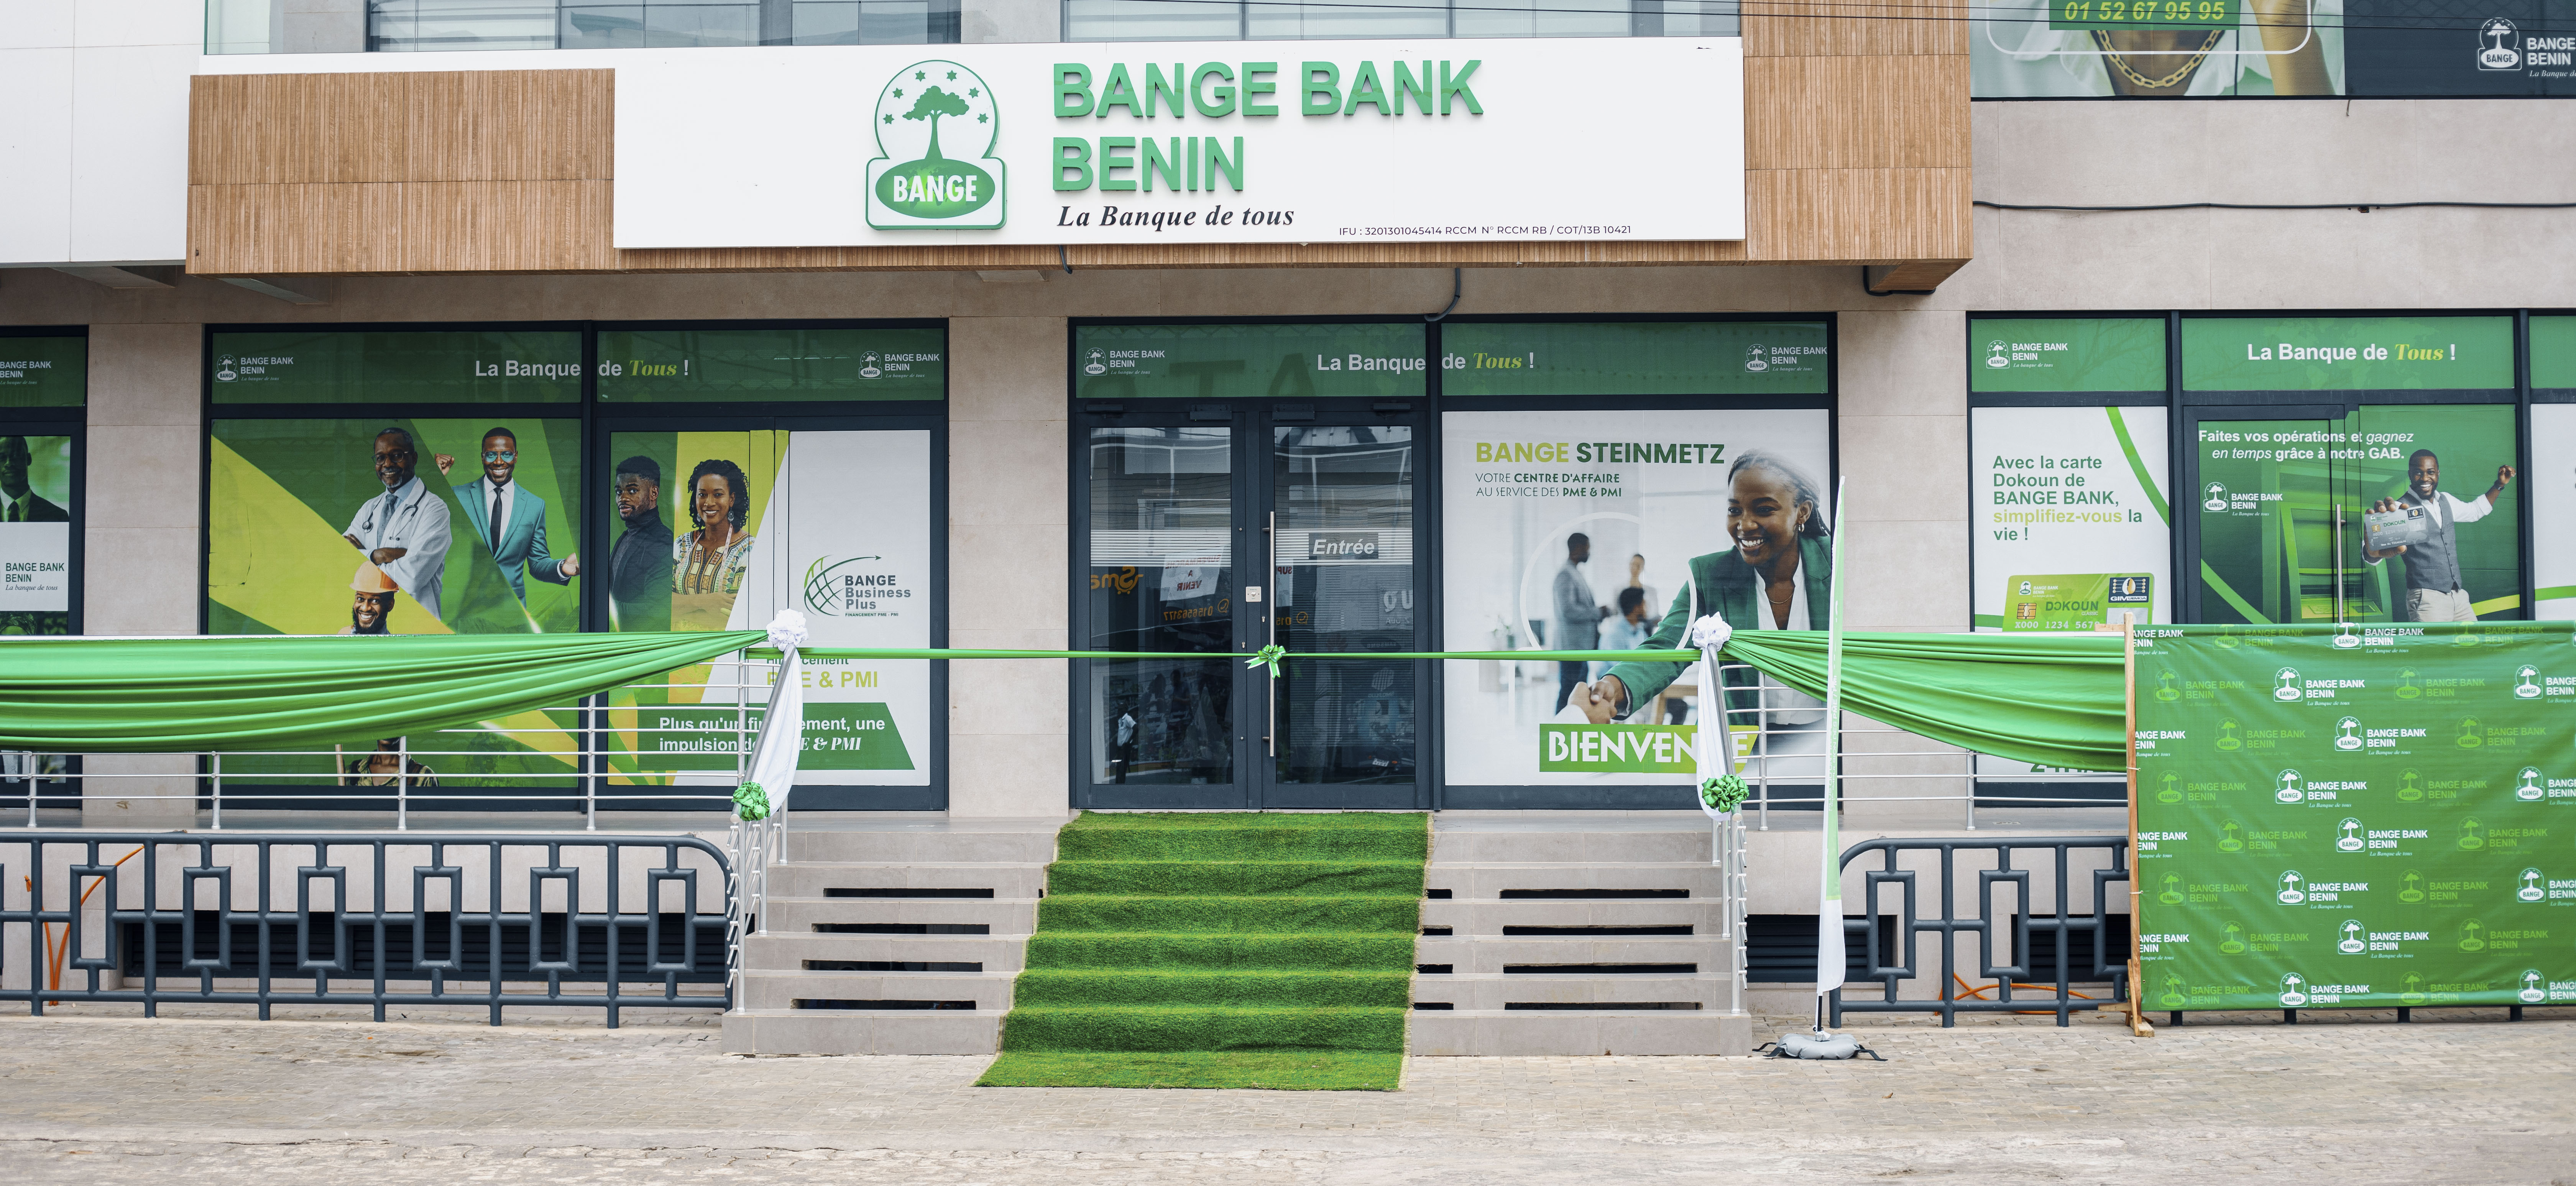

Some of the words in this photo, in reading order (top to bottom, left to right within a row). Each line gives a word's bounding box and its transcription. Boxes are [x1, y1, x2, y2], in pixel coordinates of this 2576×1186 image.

[2065, 2, 2090, 20] 01
[2098, 2, 2126, 20] 52
[2132, 2, 2158, 20] 67
[2164, 2, 2191, 20] 95
[2198, 2, 2225, 20] 95
[2527, 37, 2576, 50] BANGE
[2486, 54, 2513, 62] BANGE
[2527, 53, 2571, 65] BENIN
[2541, 70, 2568, 79] Banque
[1053, 62, 1278, 119] BANGE
[1302, 60, 1484, 117] BANK
[1053, 135, 1243, 192] BENIN
[894, 175, 977, 202] BANGE
[1056, 206, 1090, 226] La
[1099, 206, 1196, 232] Banque
[1205, 205, 1233, 225] de
[1242, 208, 1294, 225] tous
[1365, 227, 1442, 235] 3201301045414
[1549, 225, 1554, 235] /
[1557, 225, 1600, 235] COT/13B
[2012, 343, 2042, 351] BANGE
[2044, 343, 2068, 351] BANK
[2247, 343, 2272, 360] La
[2278, 343, 2357, 364] Banque
[2362, 343, 2388, 360] de
[2395, 343, 2444, 361] Tous
[2450, 343, 2456, 360] !
[476, 360, 498, 376] La
[506, 360, 581, 380] Banque
[598, 360, 622, 376] de
[629, 360, 677, 376] Tous
[684, 360, 688, 376] !
[1318, 354, 1341, 371] La
[1349, 354, 1426, 375] Banque
[1442, 353, 1466, 369] de
[1473, 353, 1522, 369] Tous
[1530, 352, 1534, 368] !
[2199, 430, 2240, 442] Faites
[2244, 433, 2269, 442] vos
[2273, 430, 2346, 445] opérations
[2351, 431, 2362, 442] et
[2366, 433, 2414, 445] gagnez
[1477, 442, 1569, 463] BANGE
[1577, 442, 1724, 464] STEINMETZ
[2212, 450, 2228, 458] en
[2232, 447, 2272, 462] temps
[2275, 447, 2314, 462] grâce
[2318, 447, 2326, 459] à
[2331, 448, 2365, 459] notre
[2369, 447, 2404, 459] GAB.
[1993, 455, 2034, 469] Avec
[2040, 455, 2054, 469] la
[2060, 456, 2102, 469] carte
[1475, 473, 1510, 483] VOTRE
[1514, 473, 1558, 483] CENTRE
[1562, 473, 1620, 483] D'AFFAIRE
[1994, 473, 2058, 487] Dokoun
[2065, 473, 2085, 487] de
[1476, 487, 1492, 496] AU
[1496, 487, 1538, 496] SERVICE
[1541, 487, 1559, 496] DES
[1563, 487, 1586, 497] PME
[1590, 487, 1597, 497] &
[1601, 488, 1622, 497] PMI
[1994, 491, 2057, 505] BANGE
[2063, 491, 2118, 507] BANK,
[1993, 509, 2122, 526] simplifiez-vous
[2129, 509, 2142, 522] la
[1993, 527, 2018, 540] vie
[2024, 527, 2028, 540] !
[1313, 539, 1375, 554] Entrée
[6, 562, 37, 572] BANGE
[39, 563, 64, 572] BANK
[6, 574, 31, 582] BENIN
[845, 575, 896, 586] BANGE
[845, 587, 911, 598] Business
[846, 599, 876, 609] Plus
[2045, 620, 2069, 629] 1234
[767, 671, 812, 688] PE
[819, 671, 833, 688] &
[841, 671, 878, 688] PMI
[2306, 680, 2338, 688] BANGE
[2339, 679, 2365, 688] BANK
[2306, 690, 2334, 698] BENIN
[659, 717, 694, 729] Plus
[856, 719, 885, 730] une
[659, 737, 738, 752] impulsion
[813, 737, 828, 751] &
[830, 737, 862, 751] PMI
[1549, 731, 1748, 764] BIENVENE
[2369, 830, 2400, 839] BANGE
[2402, 830, 2428, 838] BANK
[2369, 840, 2397, 848] BENIN
